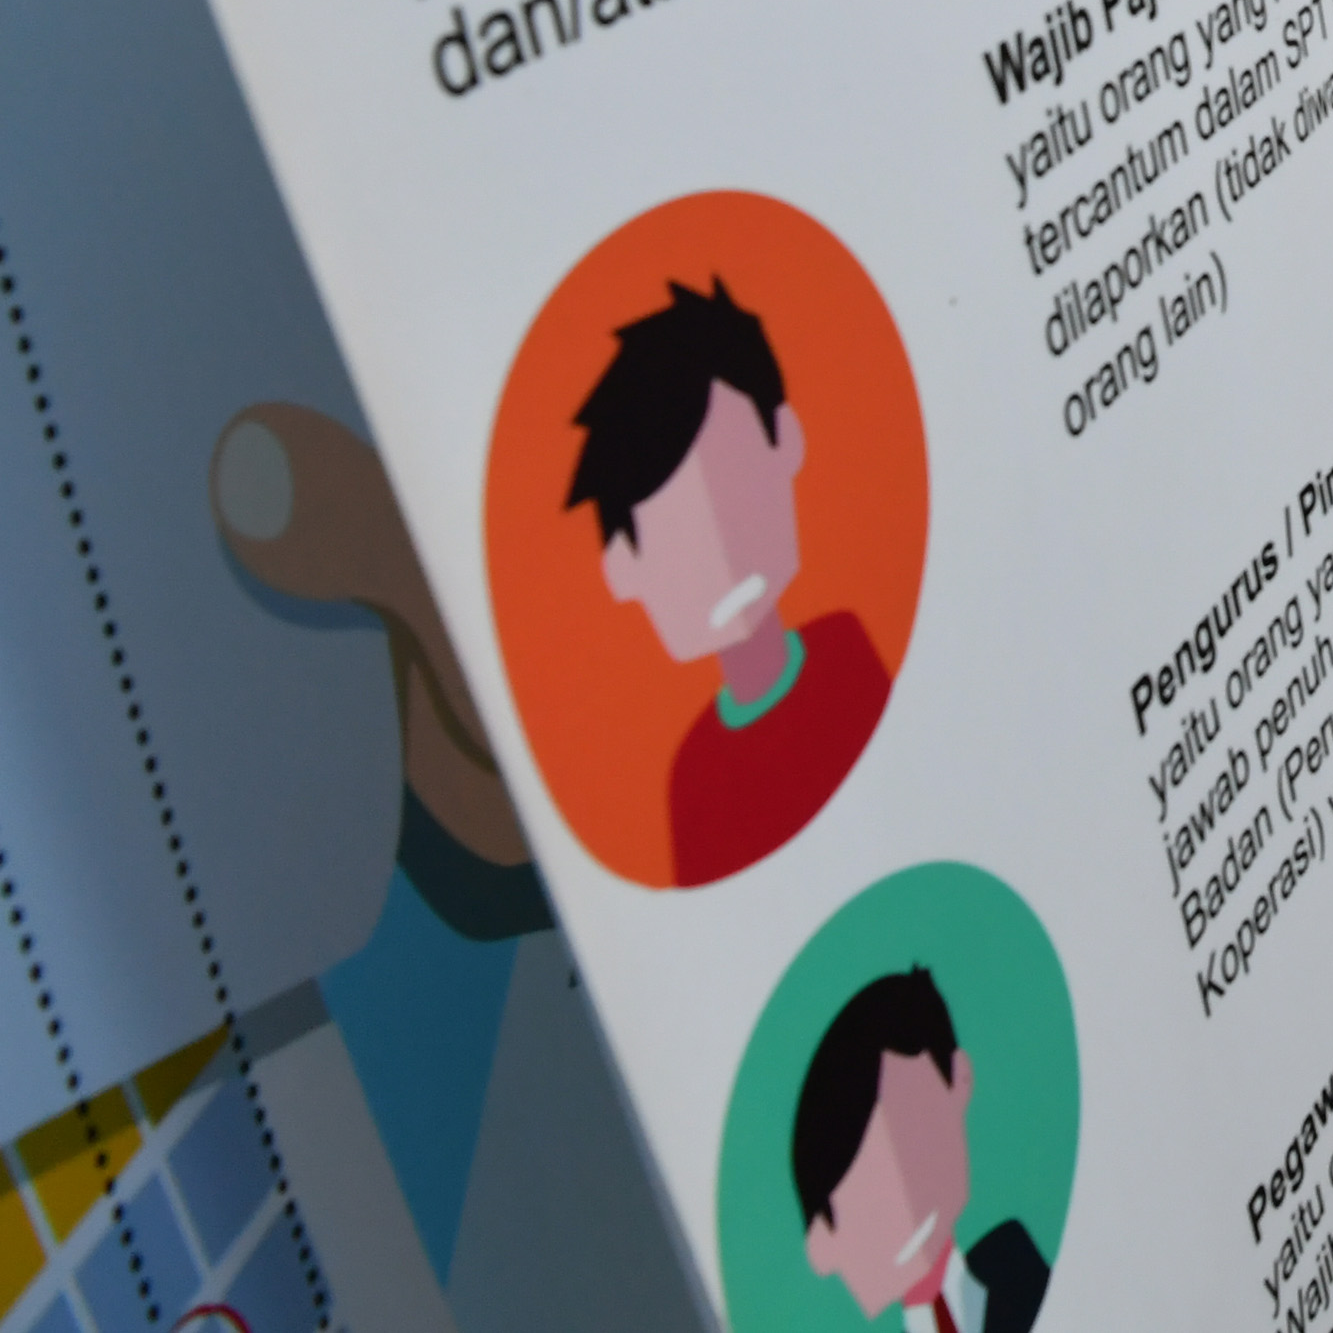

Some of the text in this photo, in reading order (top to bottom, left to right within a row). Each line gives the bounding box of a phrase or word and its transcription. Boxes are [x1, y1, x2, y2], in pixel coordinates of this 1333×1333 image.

[983, 0, 1093, 105] Wajib
[1006, 102, 1092, 209] yaitu
[1100, 32, 1191, 124] orang
[1025, 121, 1188, 275] tercantum
[1196, 51, 1280, 140] dalam
[1046, 193, 1208, 357] dilaporkan
[1216, 118, 1290, 221] (tidak
[1065, 252, 1226, 437] orang lain)
[1131, 542, 1278, 736] Pengurus
[1149, 699, 1220, 823] yaitu
[1227, 596, 1303, 709] orang
[1164, 749, 1249, 898] jawab
[1255, 636, 1333, 772] penuh
[1181, 806, 1272, 949] Badan
[1198, 808, 1324, 1017] Koperasi)
[1264, 1185, 1324, 1319] yaitu
